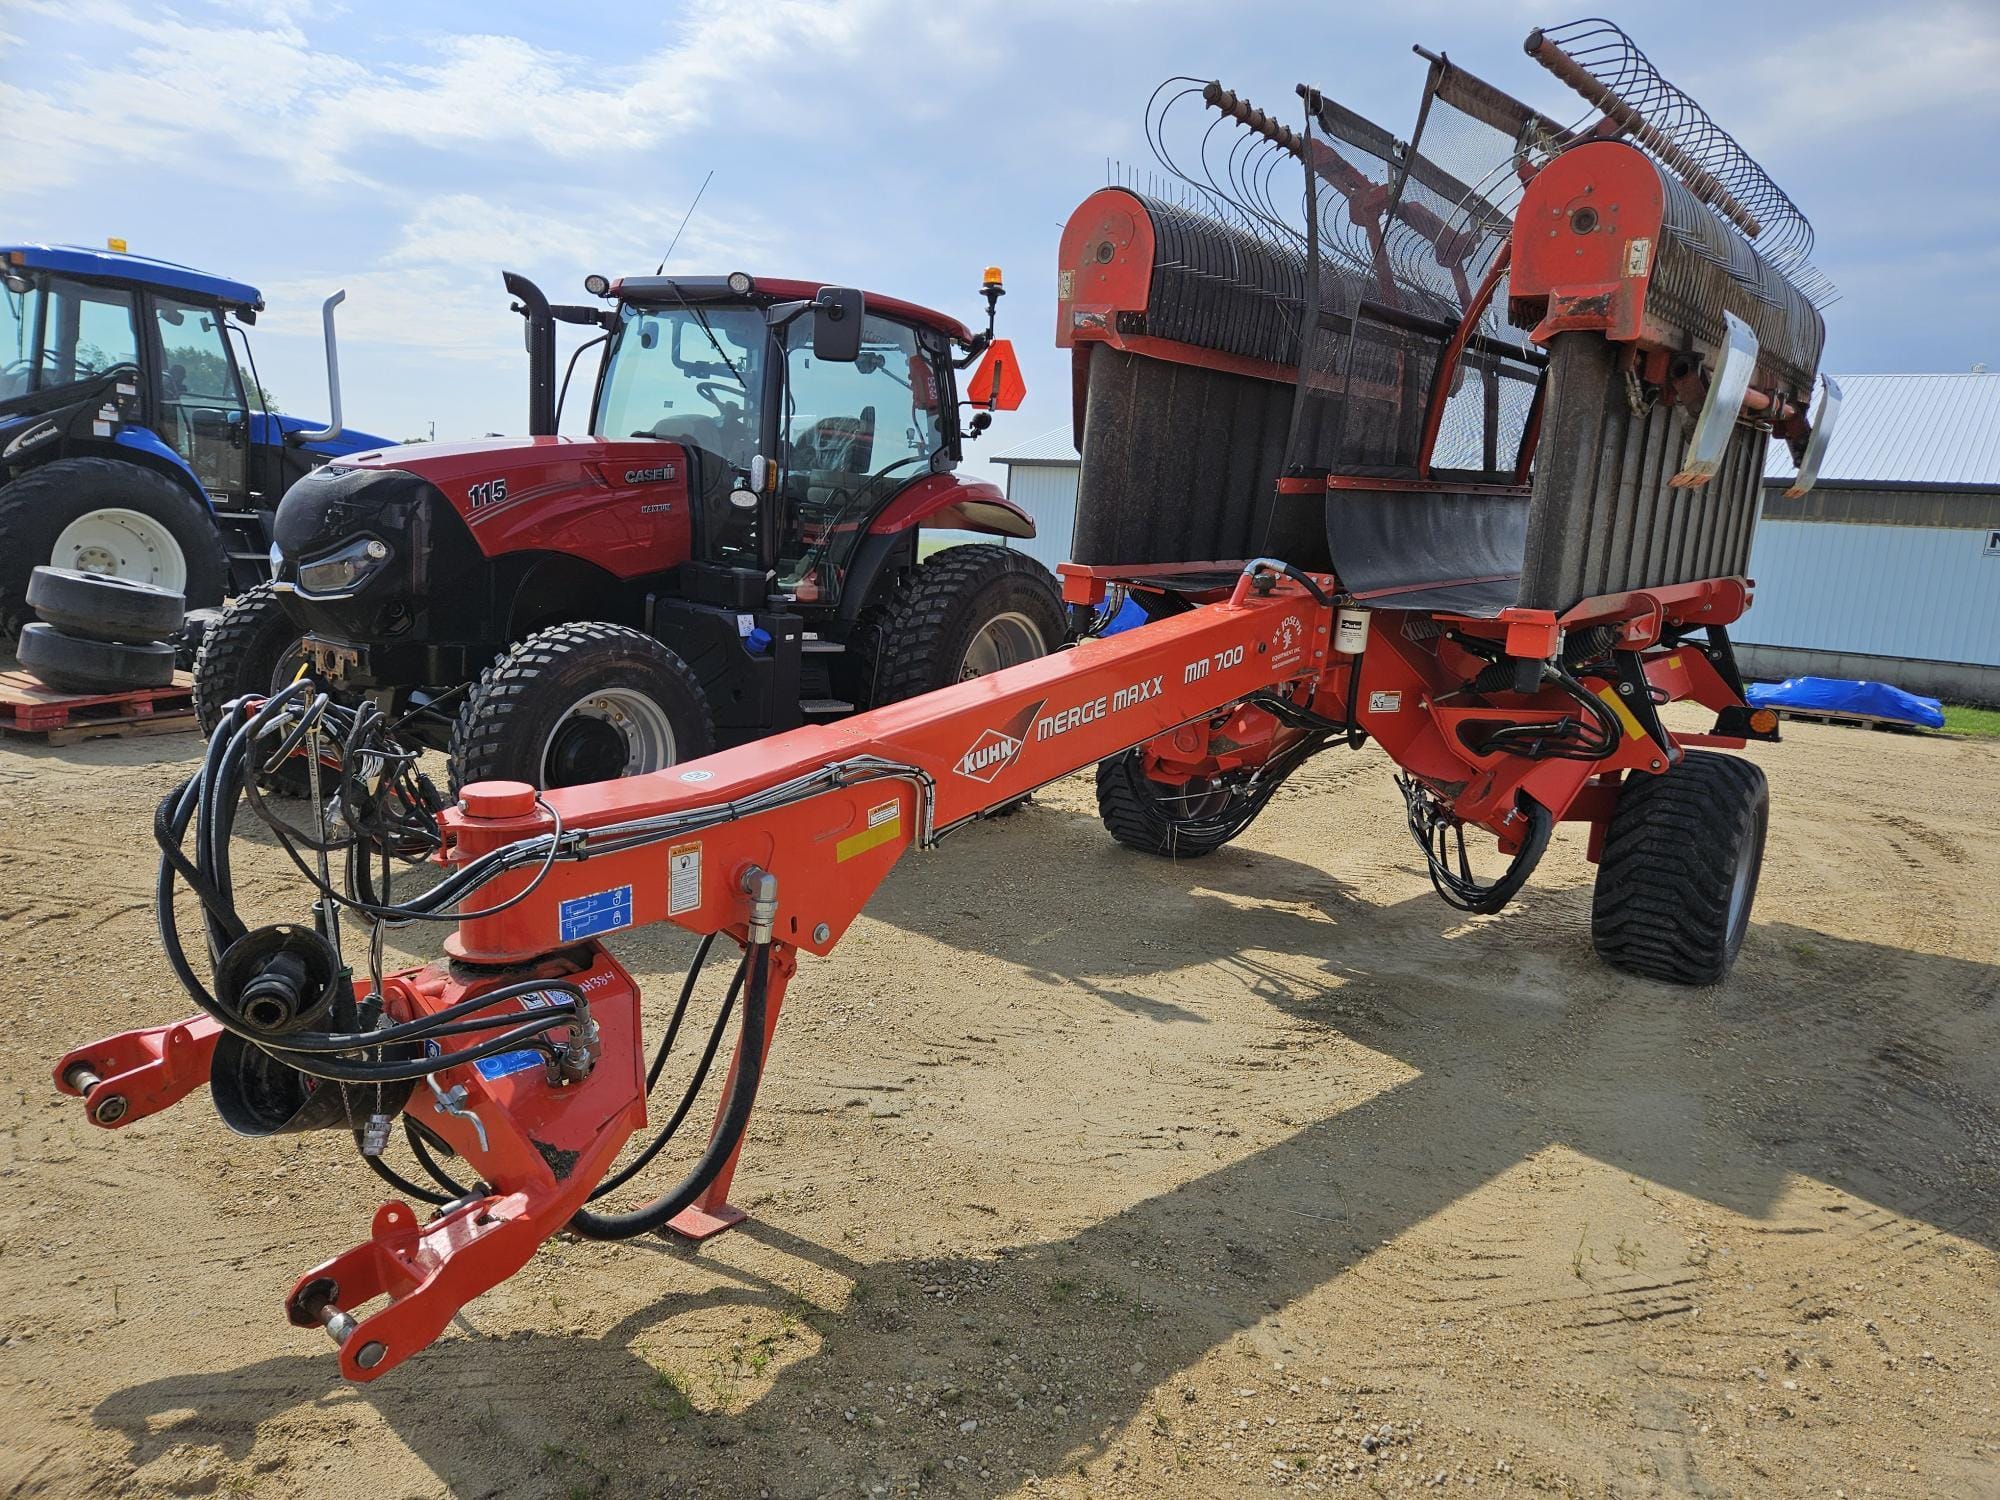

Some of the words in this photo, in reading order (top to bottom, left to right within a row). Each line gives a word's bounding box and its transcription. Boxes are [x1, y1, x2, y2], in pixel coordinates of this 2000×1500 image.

[624, 468, 663, 484] CASE
[468, 479, 507, 508] 115
[1281, 615, 1302, 636] JOSEPH
[1184, 658, 1209, 684] MM
[1214, 645, 1244, 672] 700
[1037, 696, 1107, 742] MERGE
[1112, 675, 1163, 713] MAXX
[963, 738, 1013, 775] KUHN
